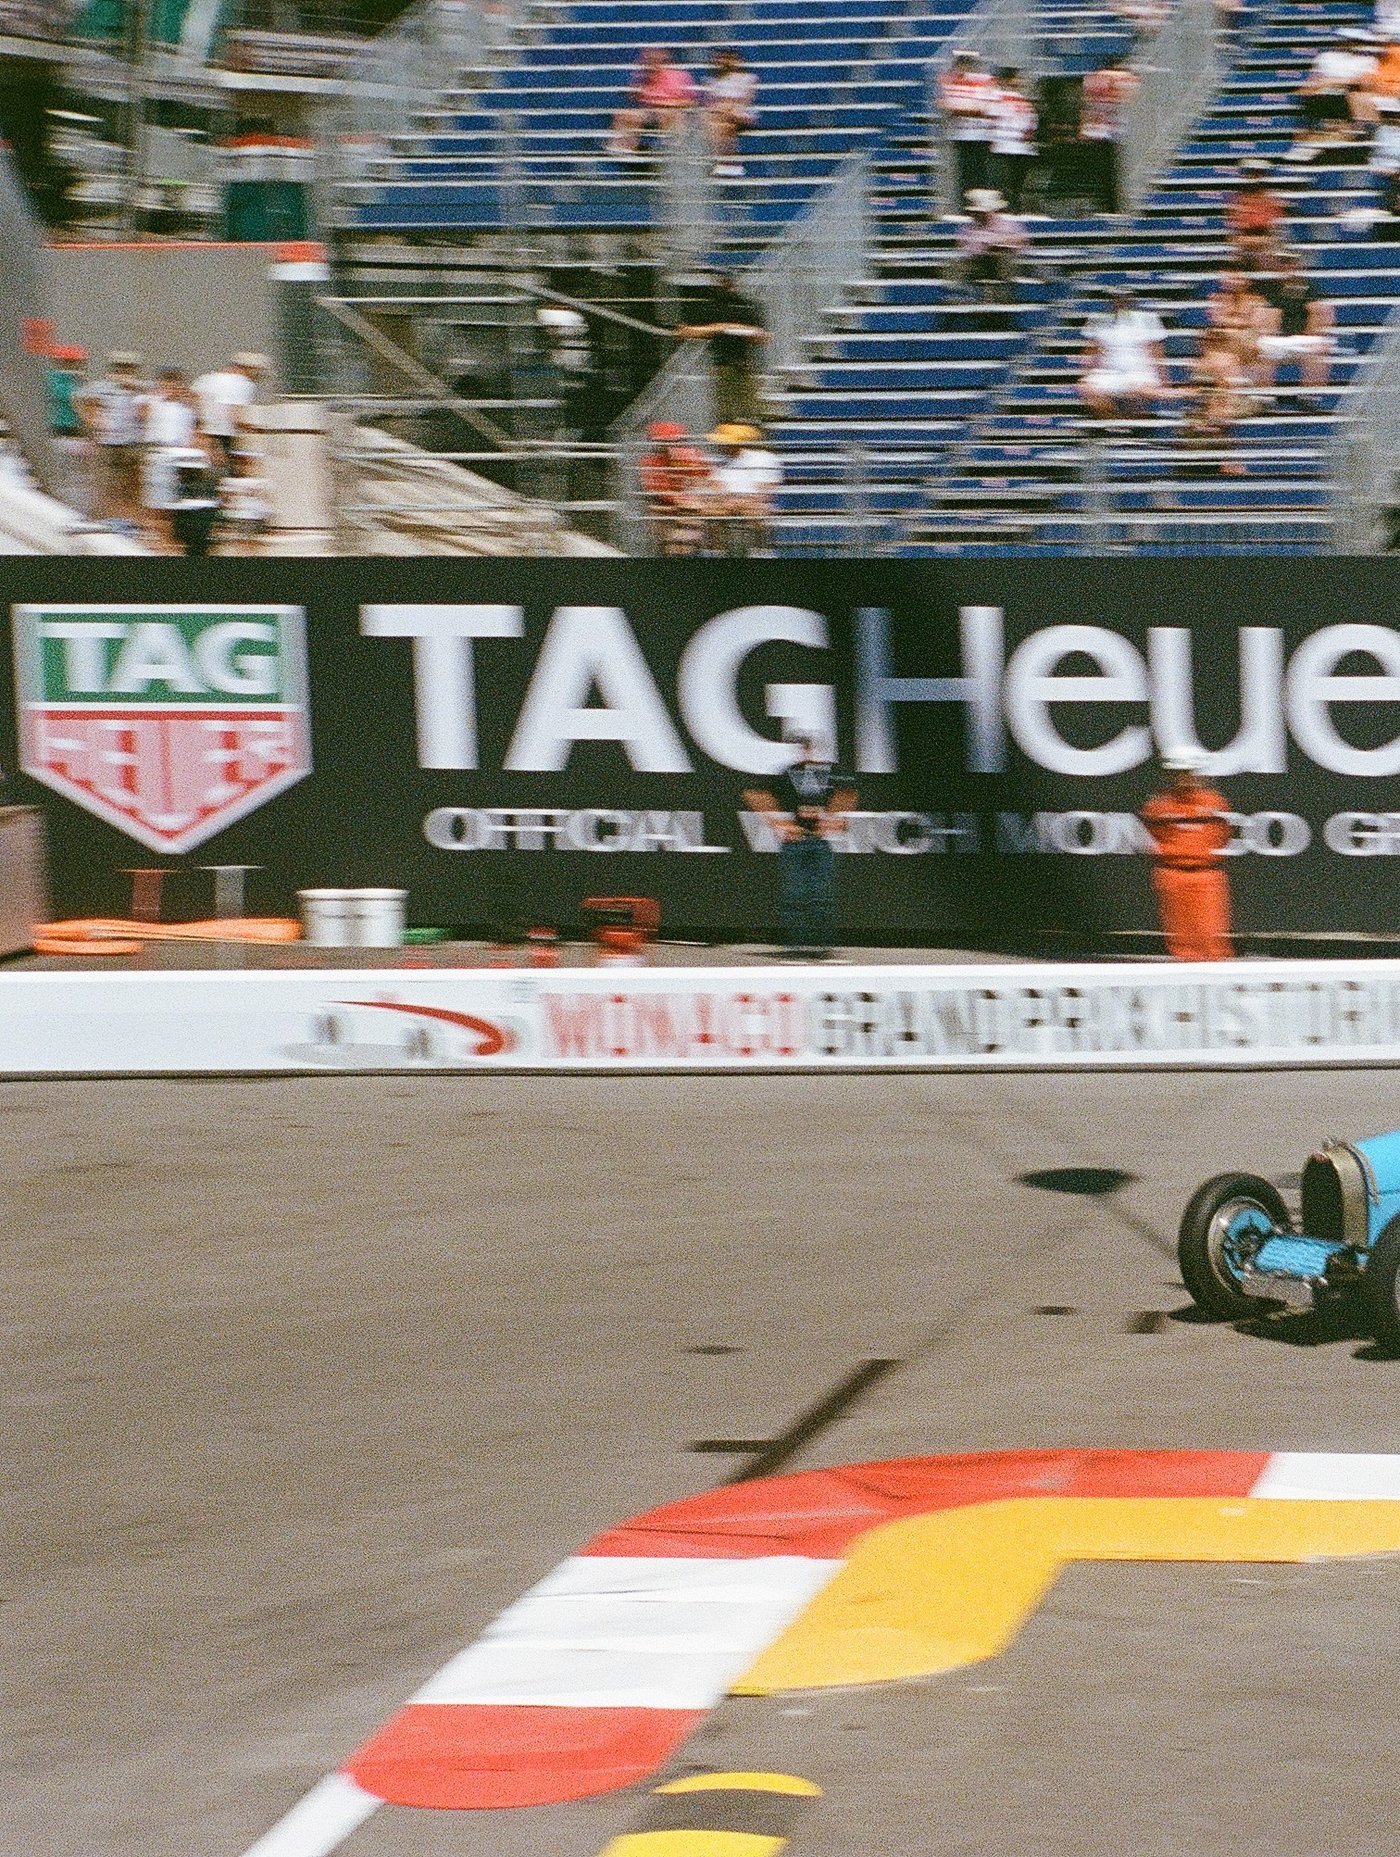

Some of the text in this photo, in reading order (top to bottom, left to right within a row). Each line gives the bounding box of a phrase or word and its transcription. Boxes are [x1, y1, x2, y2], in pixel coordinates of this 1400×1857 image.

[40, 622, 282, 694] TAG
[737, 810, 982, 855] WTCH
[999, 810, 1312, 856] MONCO
